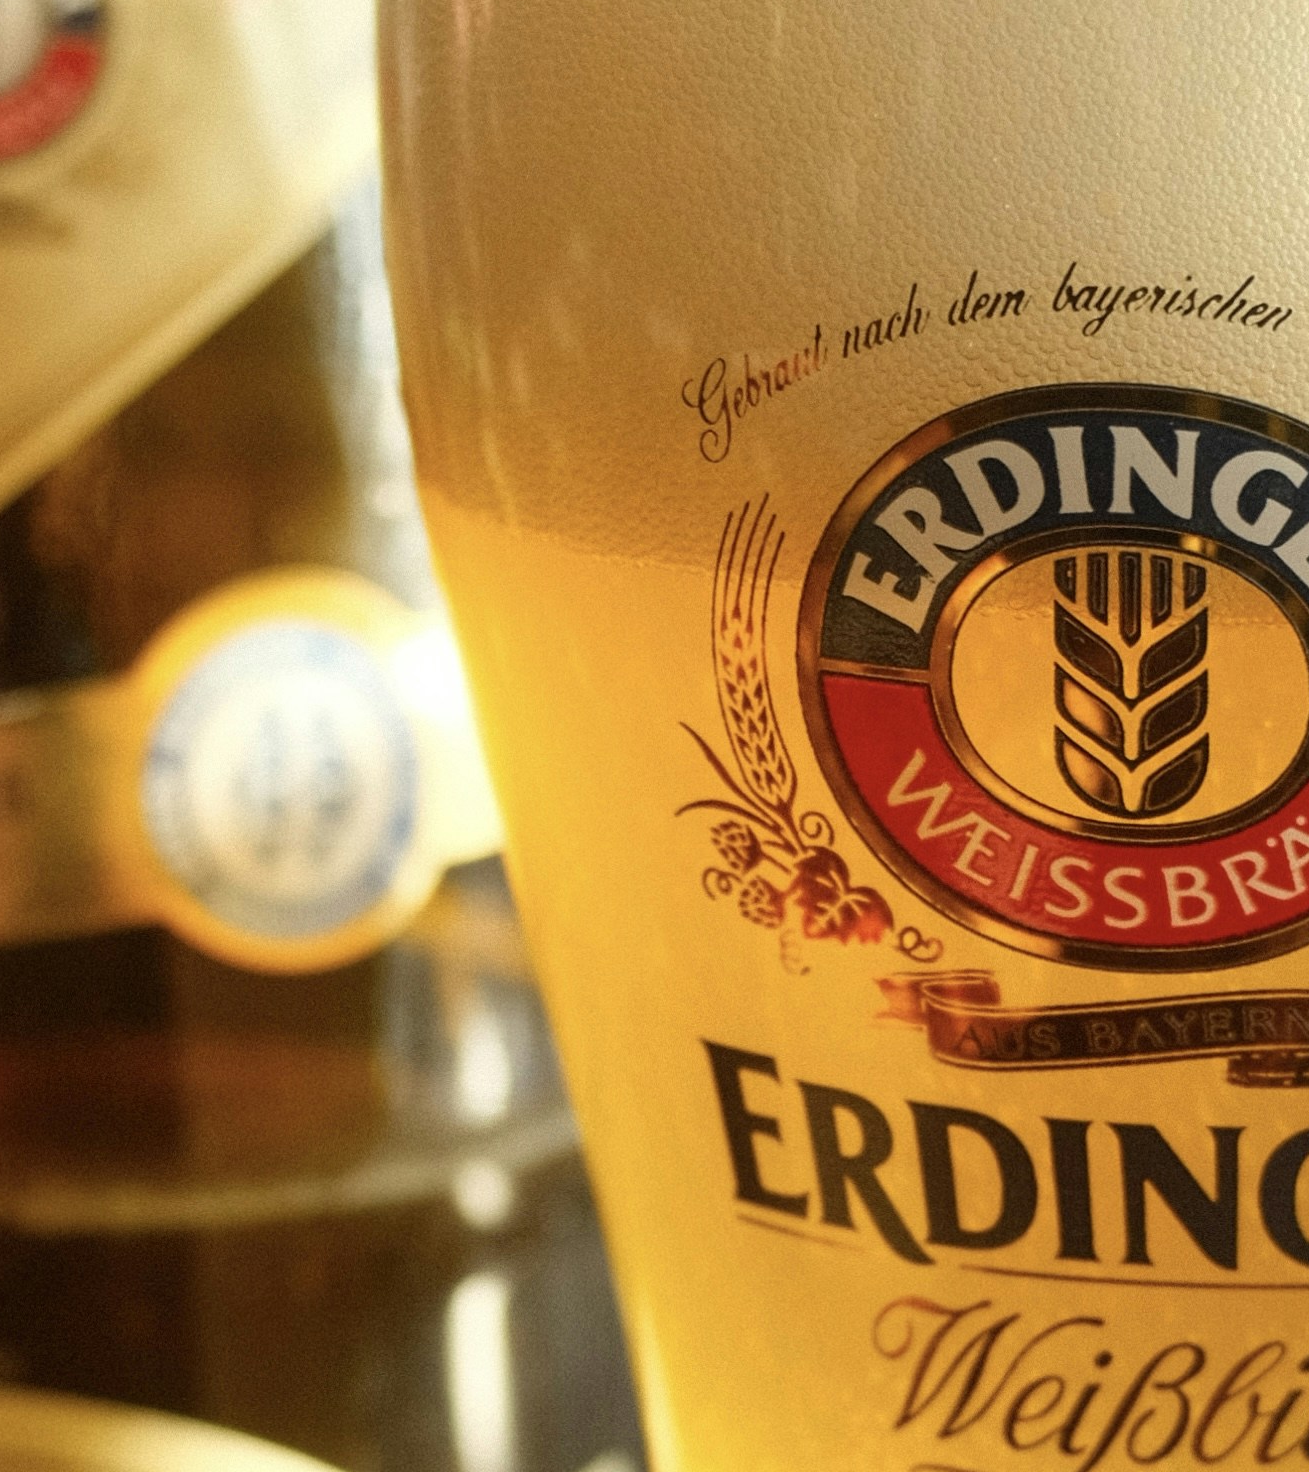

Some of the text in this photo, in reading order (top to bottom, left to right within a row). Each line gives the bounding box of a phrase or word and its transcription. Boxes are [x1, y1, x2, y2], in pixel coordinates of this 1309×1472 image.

[682, 324, 829, 463] Gebraut
[844, 283, 930, 358] nach
[947, 269, 1031, 327] dem
[1052, 261, 1293, 337] bayerischen
[954, 1022, 1062, 1060] AUS
